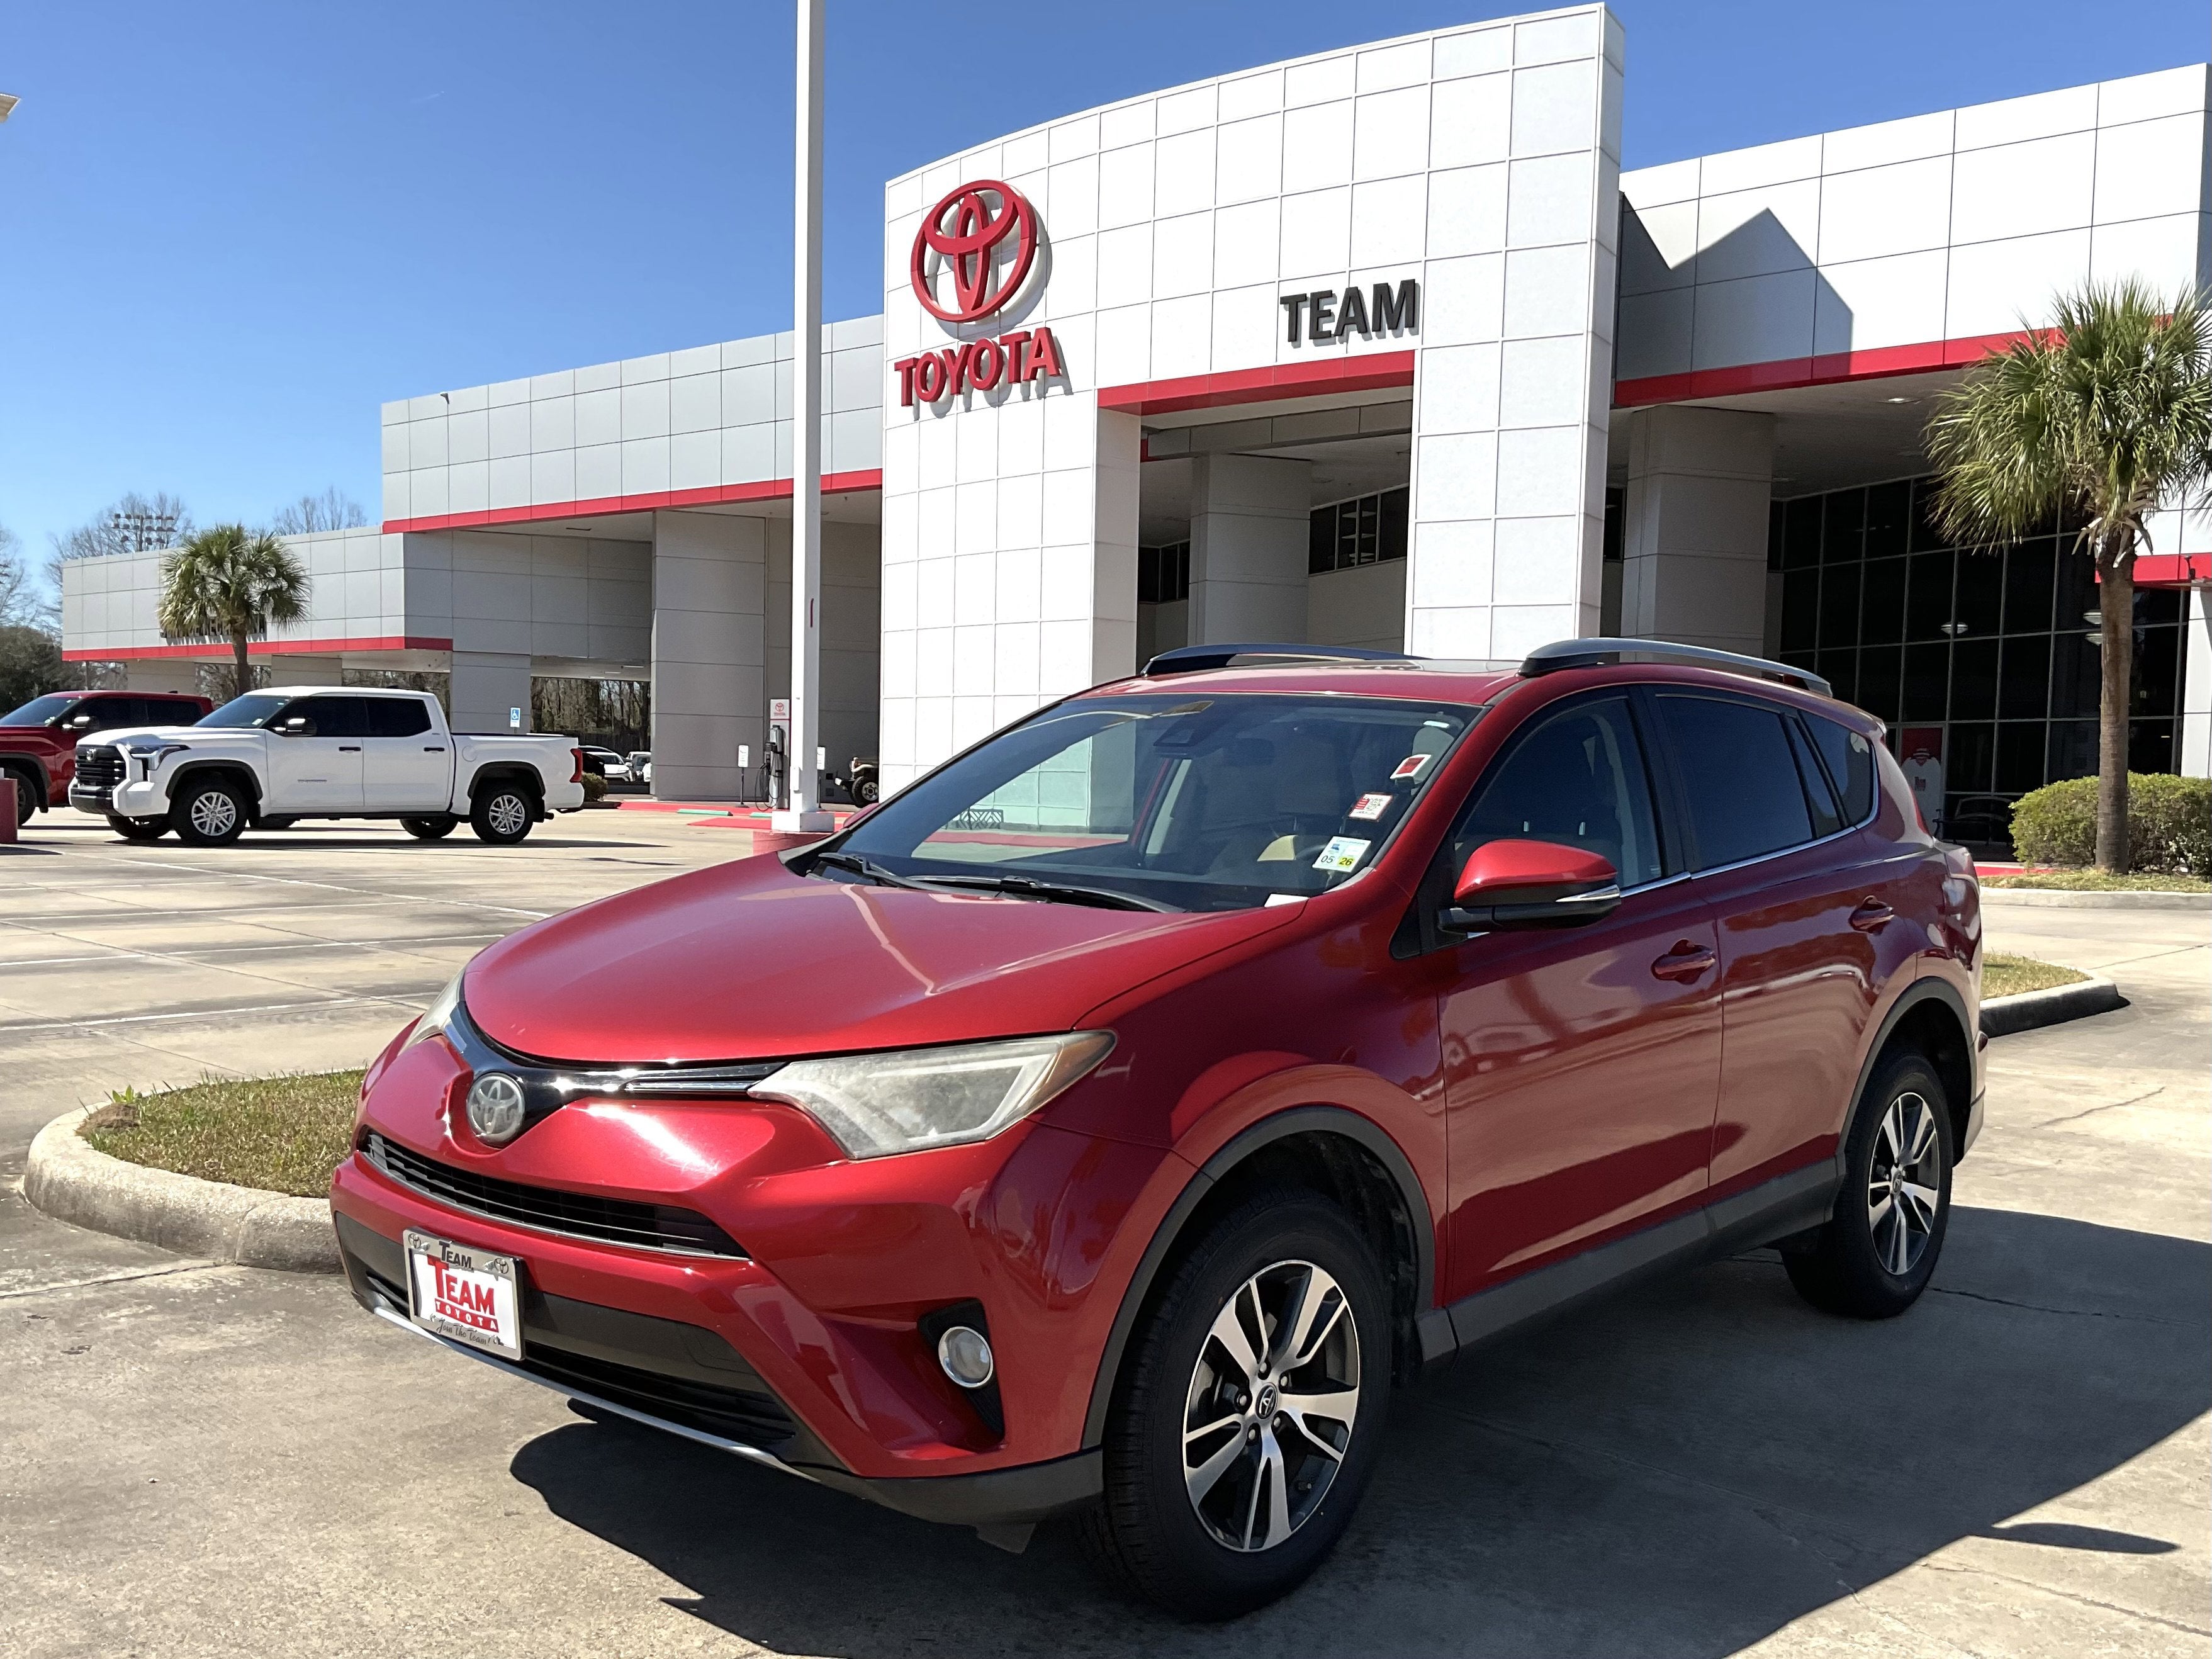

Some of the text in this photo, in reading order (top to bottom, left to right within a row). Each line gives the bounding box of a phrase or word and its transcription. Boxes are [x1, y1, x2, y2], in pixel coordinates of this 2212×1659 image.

[1280, 279, 1415, 342] TEAM
[894, 327, 1060, 407] TOYOTA
[1321, 855, 1335, 863] 05
[1339, 857, 1354, 865] 26
[427, 1254, 495, 1316] TEAM
[435, 1300, 497, 1330] TOYOTA
